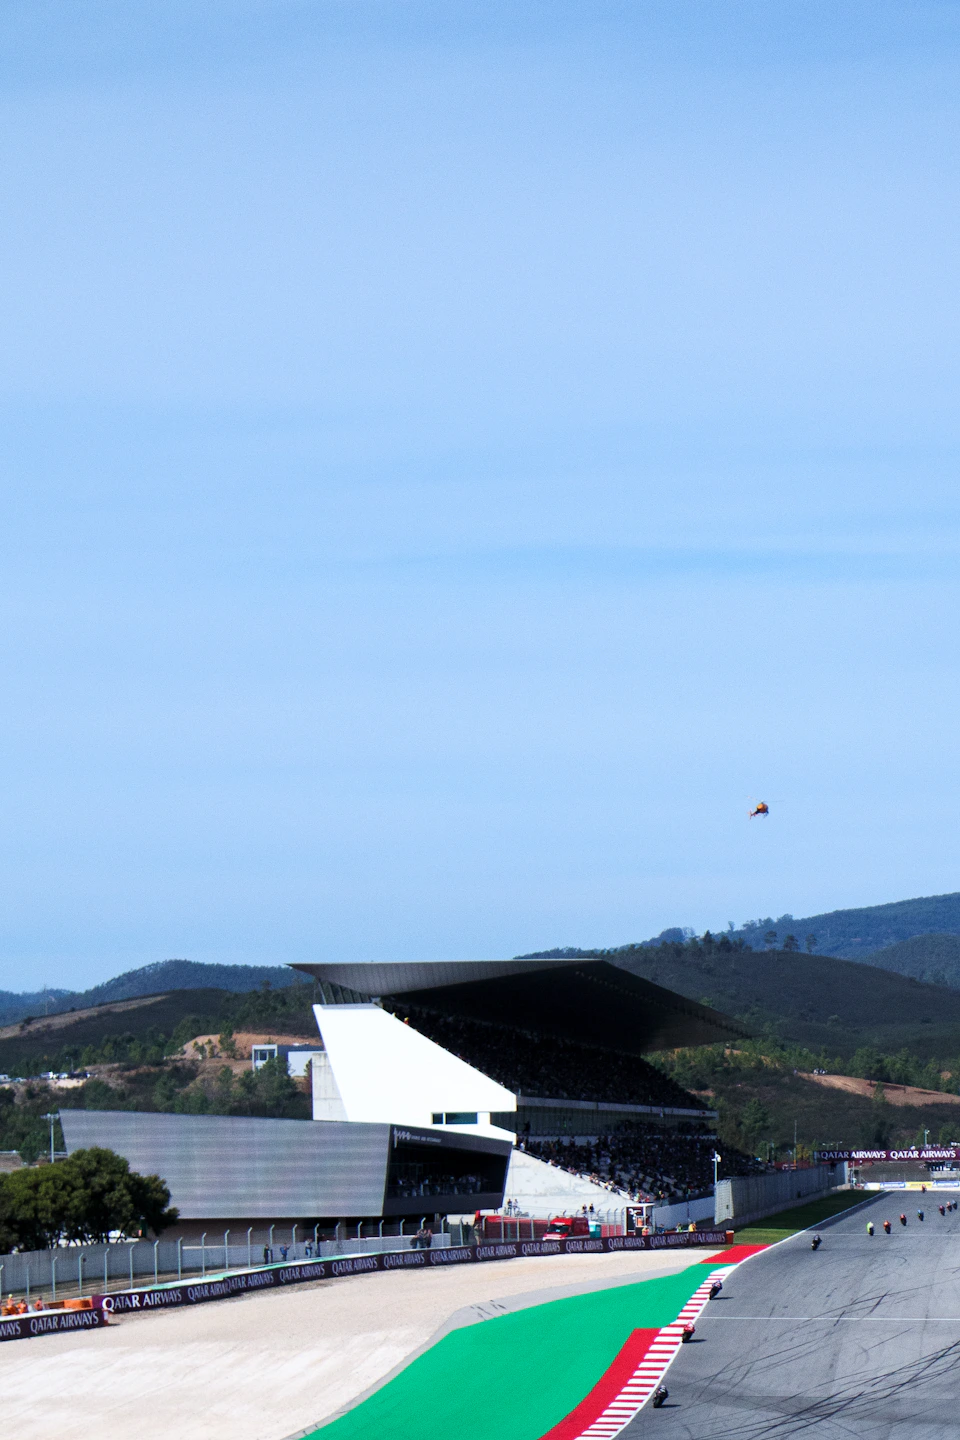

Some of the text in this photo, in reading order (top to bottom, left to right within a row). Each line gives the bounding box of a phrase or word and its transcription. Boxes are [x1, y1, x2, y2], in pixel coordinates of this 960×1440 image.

[821, 1151, 849, 1160] QATAR
[851, 1150, 886, 1158] AIRWAYS
[891, 1150, 919, 1159] QATAR
[920, 1150, 956, 1158] AIRWAYS
[226, 1276, 246, 1292] QATAR
[280, 1267, 300, 1281] QATAR
[332, 1261, 352, 1276] QATAR
[102, 1294, 140, 1312] QATAR
[142, 1289, 182, 1306] AIRWAYS
[188, 1284, 209, 1300] QATAR
[30, 1316, 58, 1334] QATAR
[60, 1311, 99, 1328] AIRWAYS
